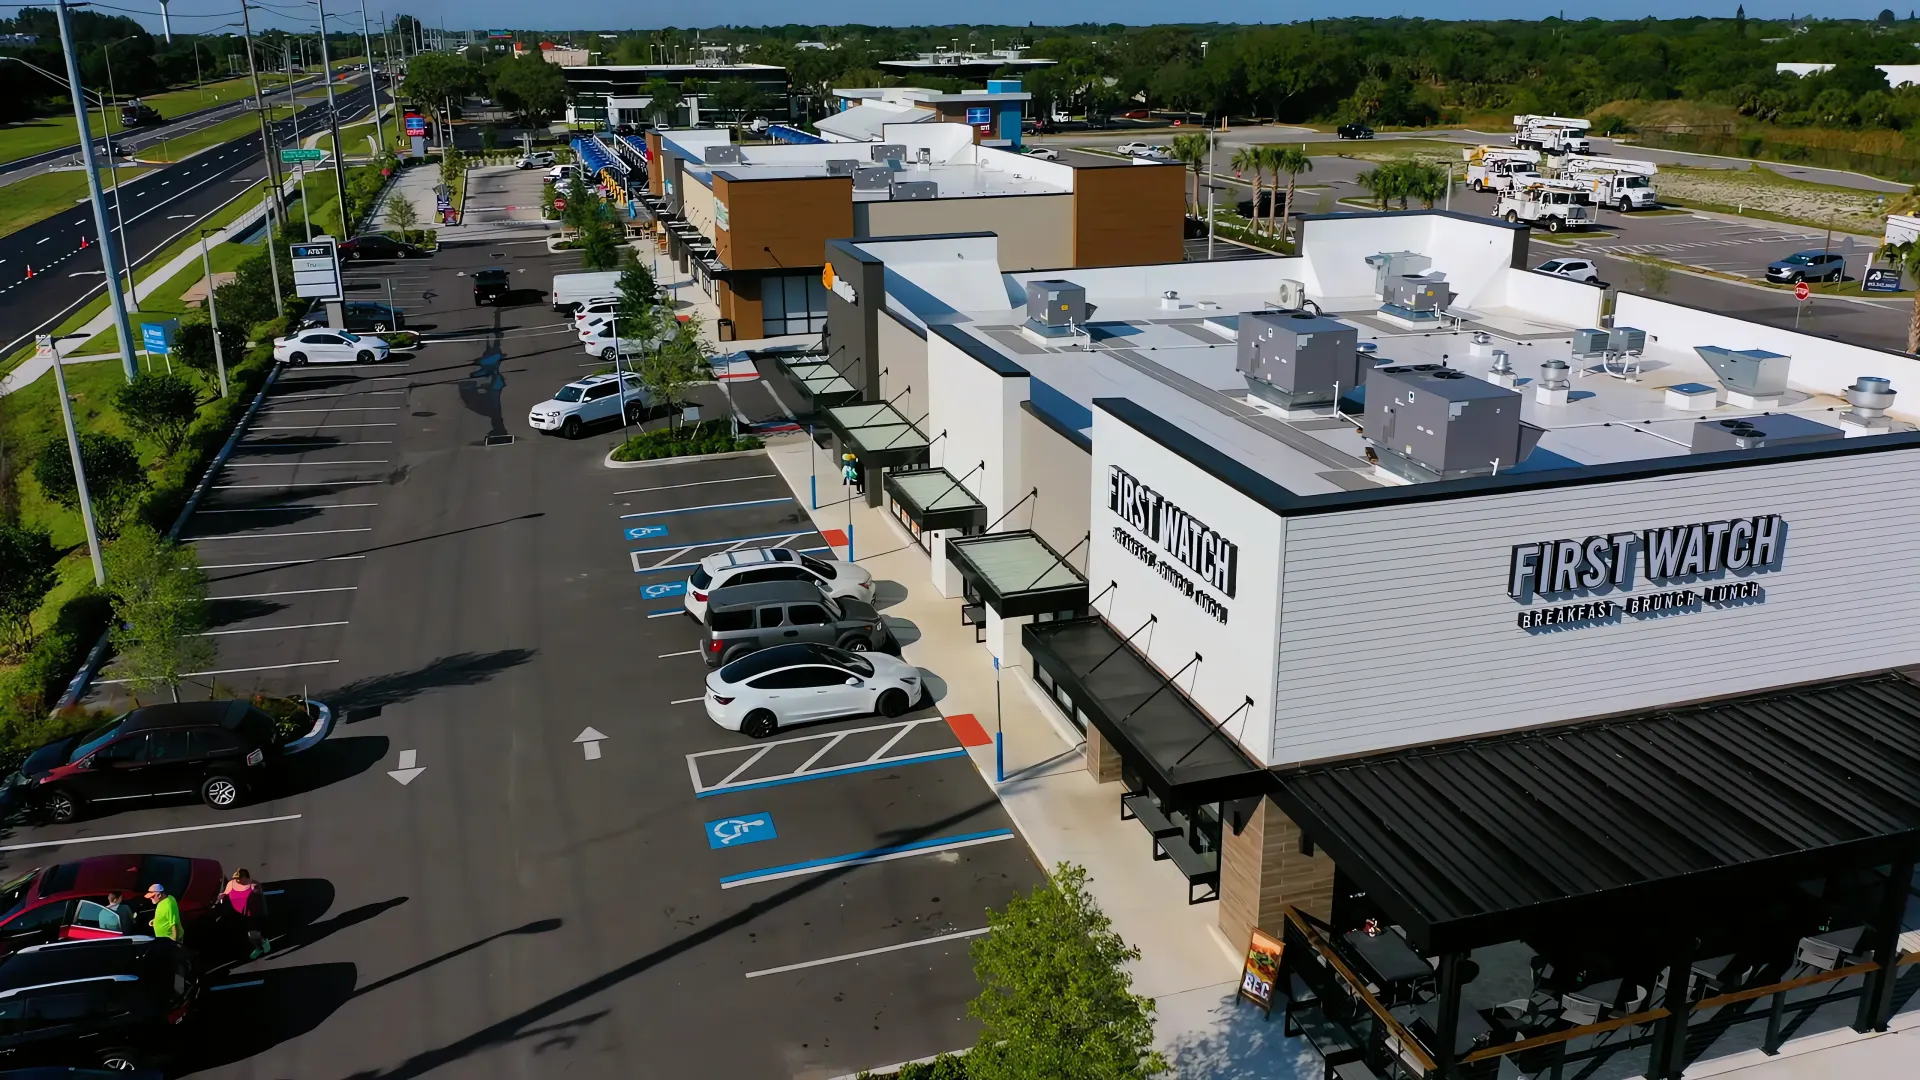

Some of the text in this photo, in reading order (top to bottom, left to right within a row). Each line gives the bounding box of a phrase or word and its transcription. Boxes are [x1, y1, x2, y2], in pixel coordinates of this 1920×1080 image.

[1108, 465, 1236, 598] FIRST WATCH
[1113, 527, 1155, 566] BREAKFAST
[1510, 514, 1782, 599] FIRST WATCH
[1520, 582, 1760, 628] BREAKFAST BRUNCH LUNCH
